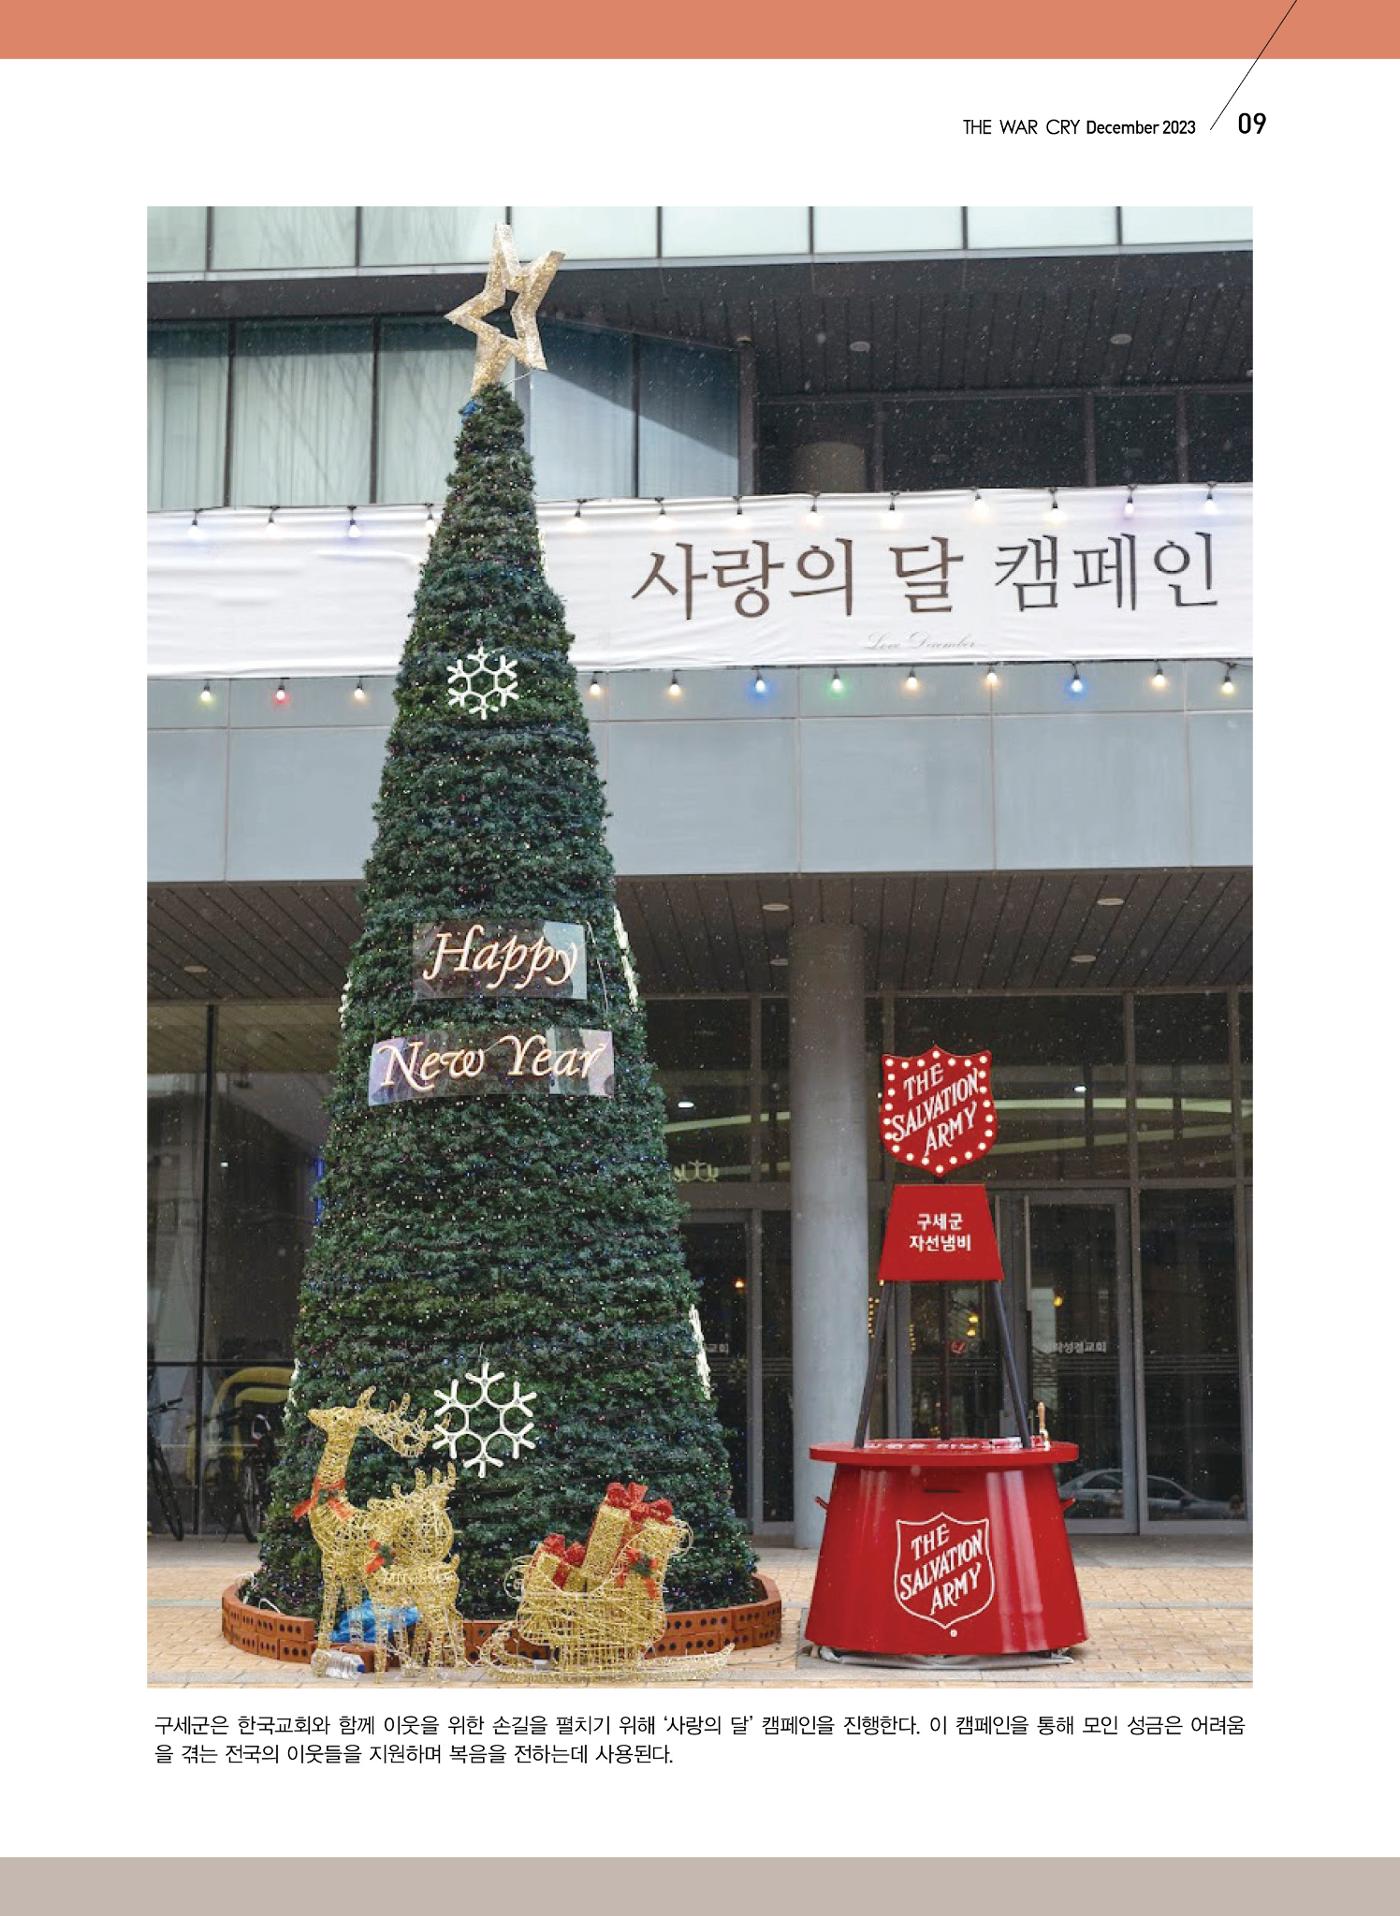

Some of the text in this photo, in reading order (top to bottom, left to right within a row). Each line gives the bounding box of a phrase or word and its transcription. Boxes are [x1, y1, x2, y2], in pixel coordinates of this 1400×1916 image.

[631, 531, 1219, 621] 사랑의 달 캠페인
[422, 924, 578, 991] Happy
[377, 1034, 607, 1093] New Year
[903, 1062, 944, 1101] THE
[892, 1067, 979, 1142] SALVATION
[924, 1100, 977, 1157] ARMY
[908, 1233, 972, 1253] 자선냄비
[916, 1212, 964, 1231] 구세군
[899, 1528, 983, 1601] SALVATION
[911, 1523, 950, 1560] THE
[929, 1561, 981, 1616] ARMY
